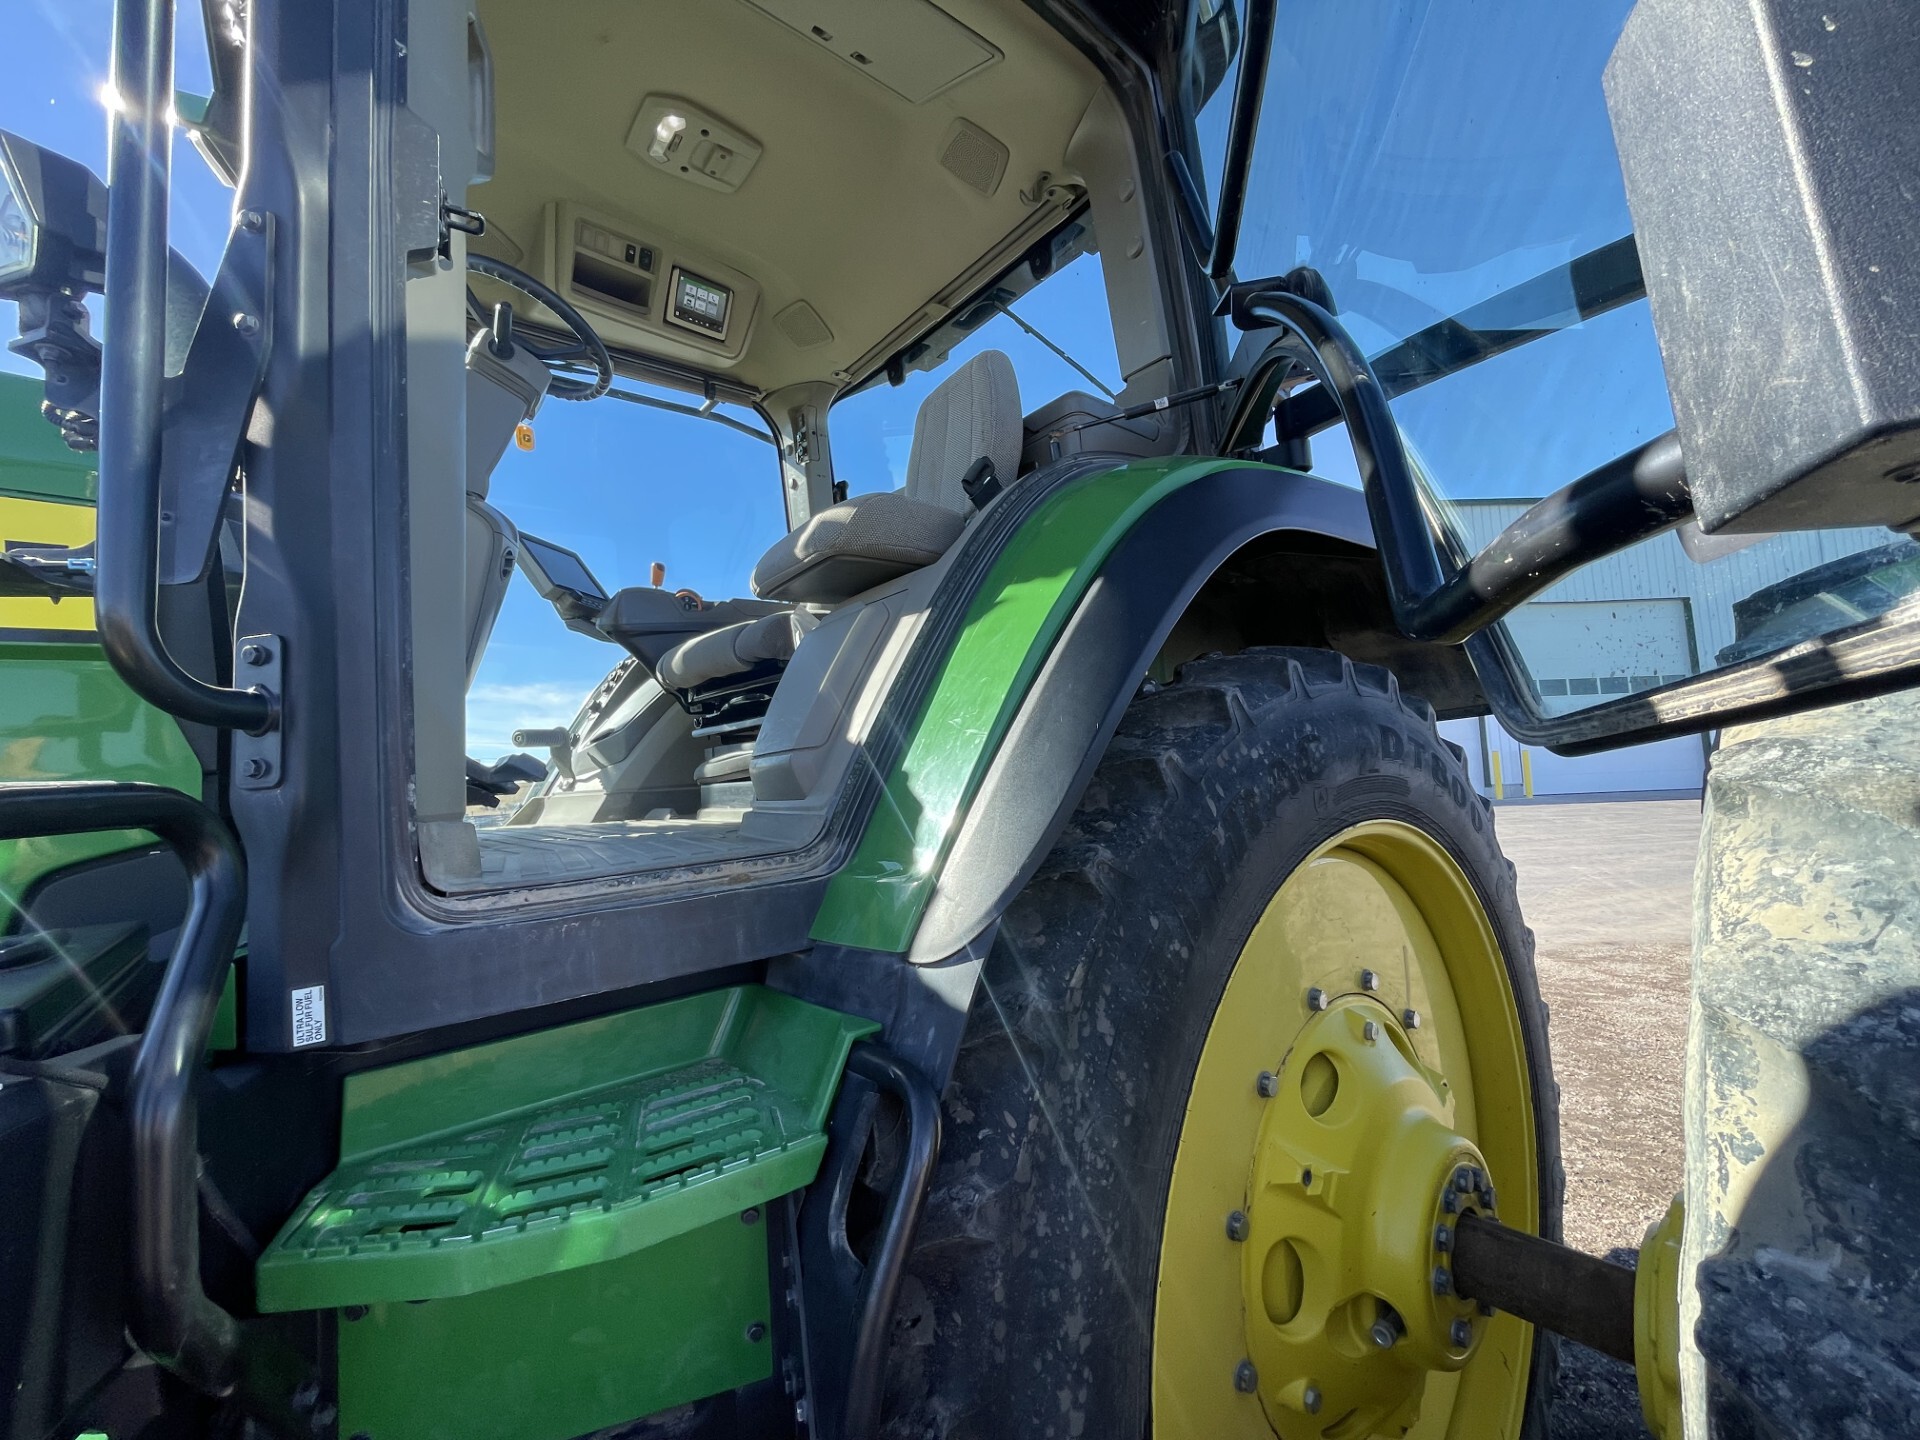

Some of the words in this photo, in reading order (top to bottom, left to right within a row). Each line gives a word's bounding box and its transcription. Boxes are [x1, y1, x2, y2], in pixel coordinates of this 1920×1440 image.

[1379, 724, 1483, 834] DT800
[296, 998, 304, 1016] LOW
[304, 989, 313, 1009] FUEL
[296, 1018, 305, 1045] ULTRA
[305, 1010, 314, 1042] SULFUR
[314, 1020, 323, 1041] ONLY
